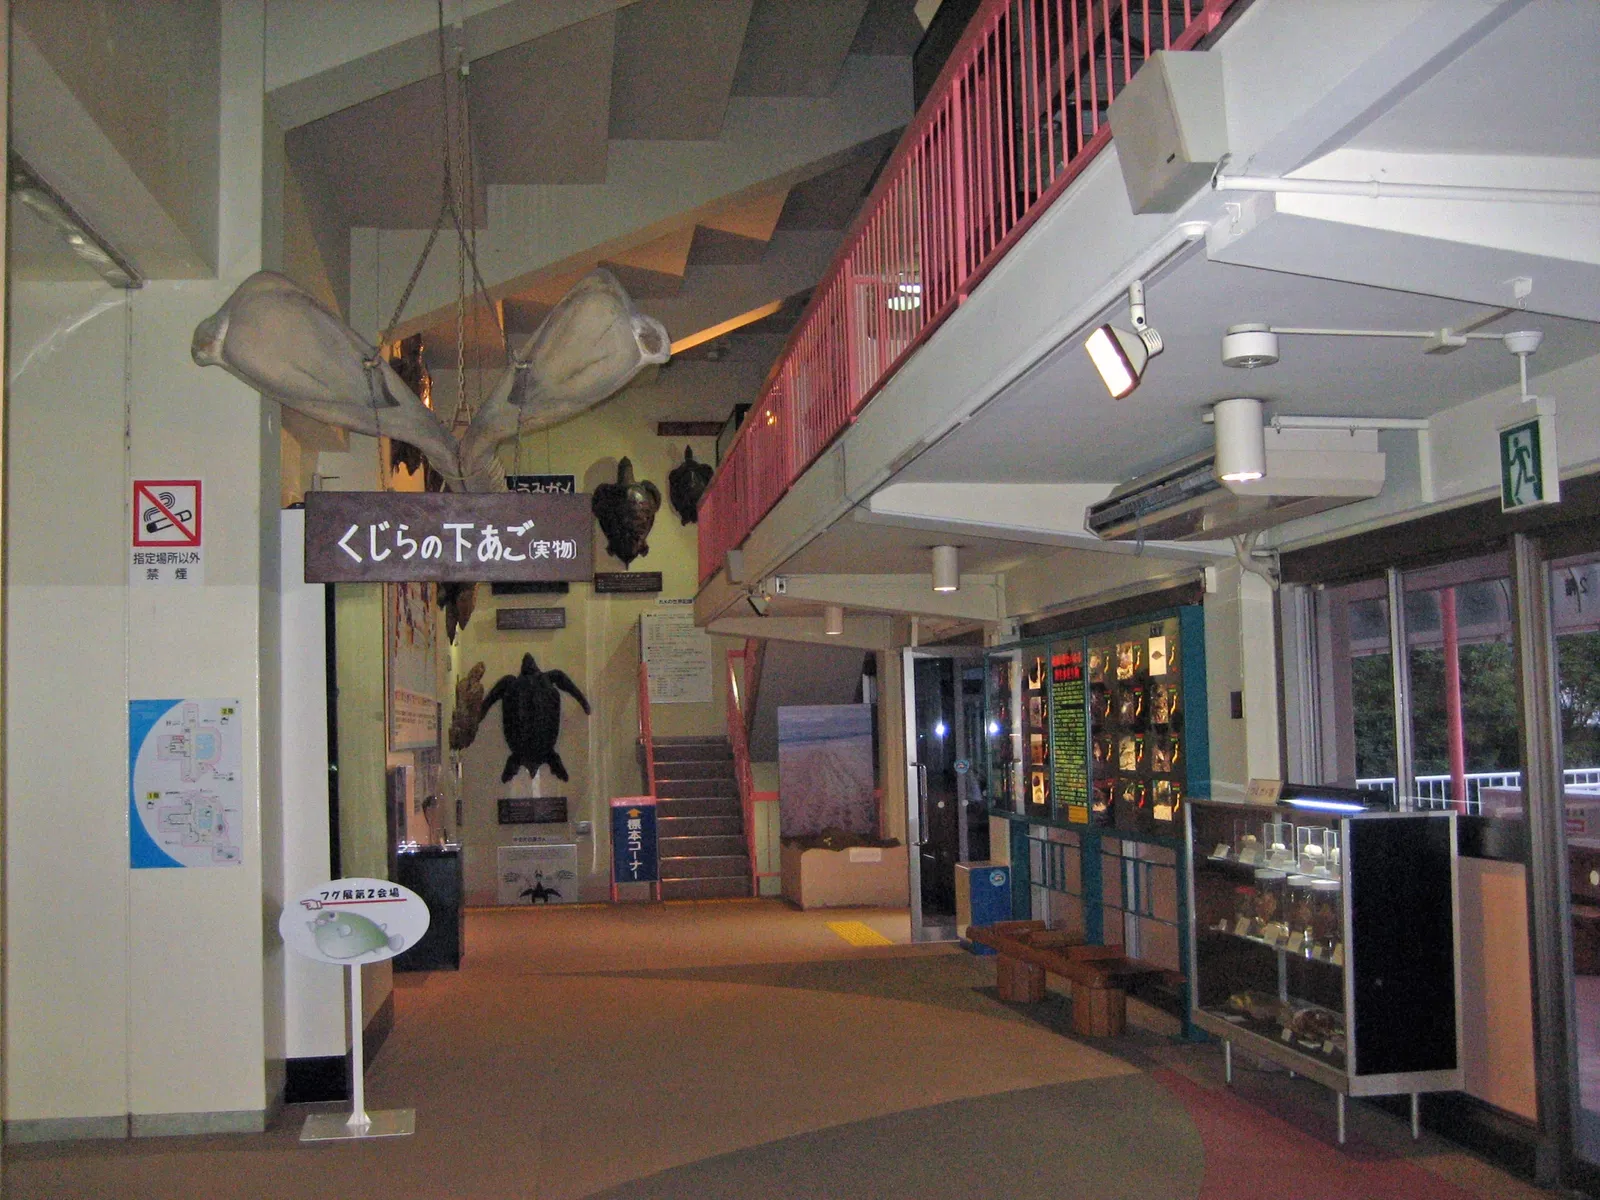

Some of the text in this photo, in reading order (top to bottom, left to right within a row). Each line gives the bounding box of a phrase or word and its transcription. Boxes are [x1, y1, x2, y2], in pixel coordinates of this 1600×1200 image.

[133, 552, 200, 565] 指定場所以外
[627, 818, 643, 880] 標本コーナー
[320, 887, 400, 901] フグ展第2会場
